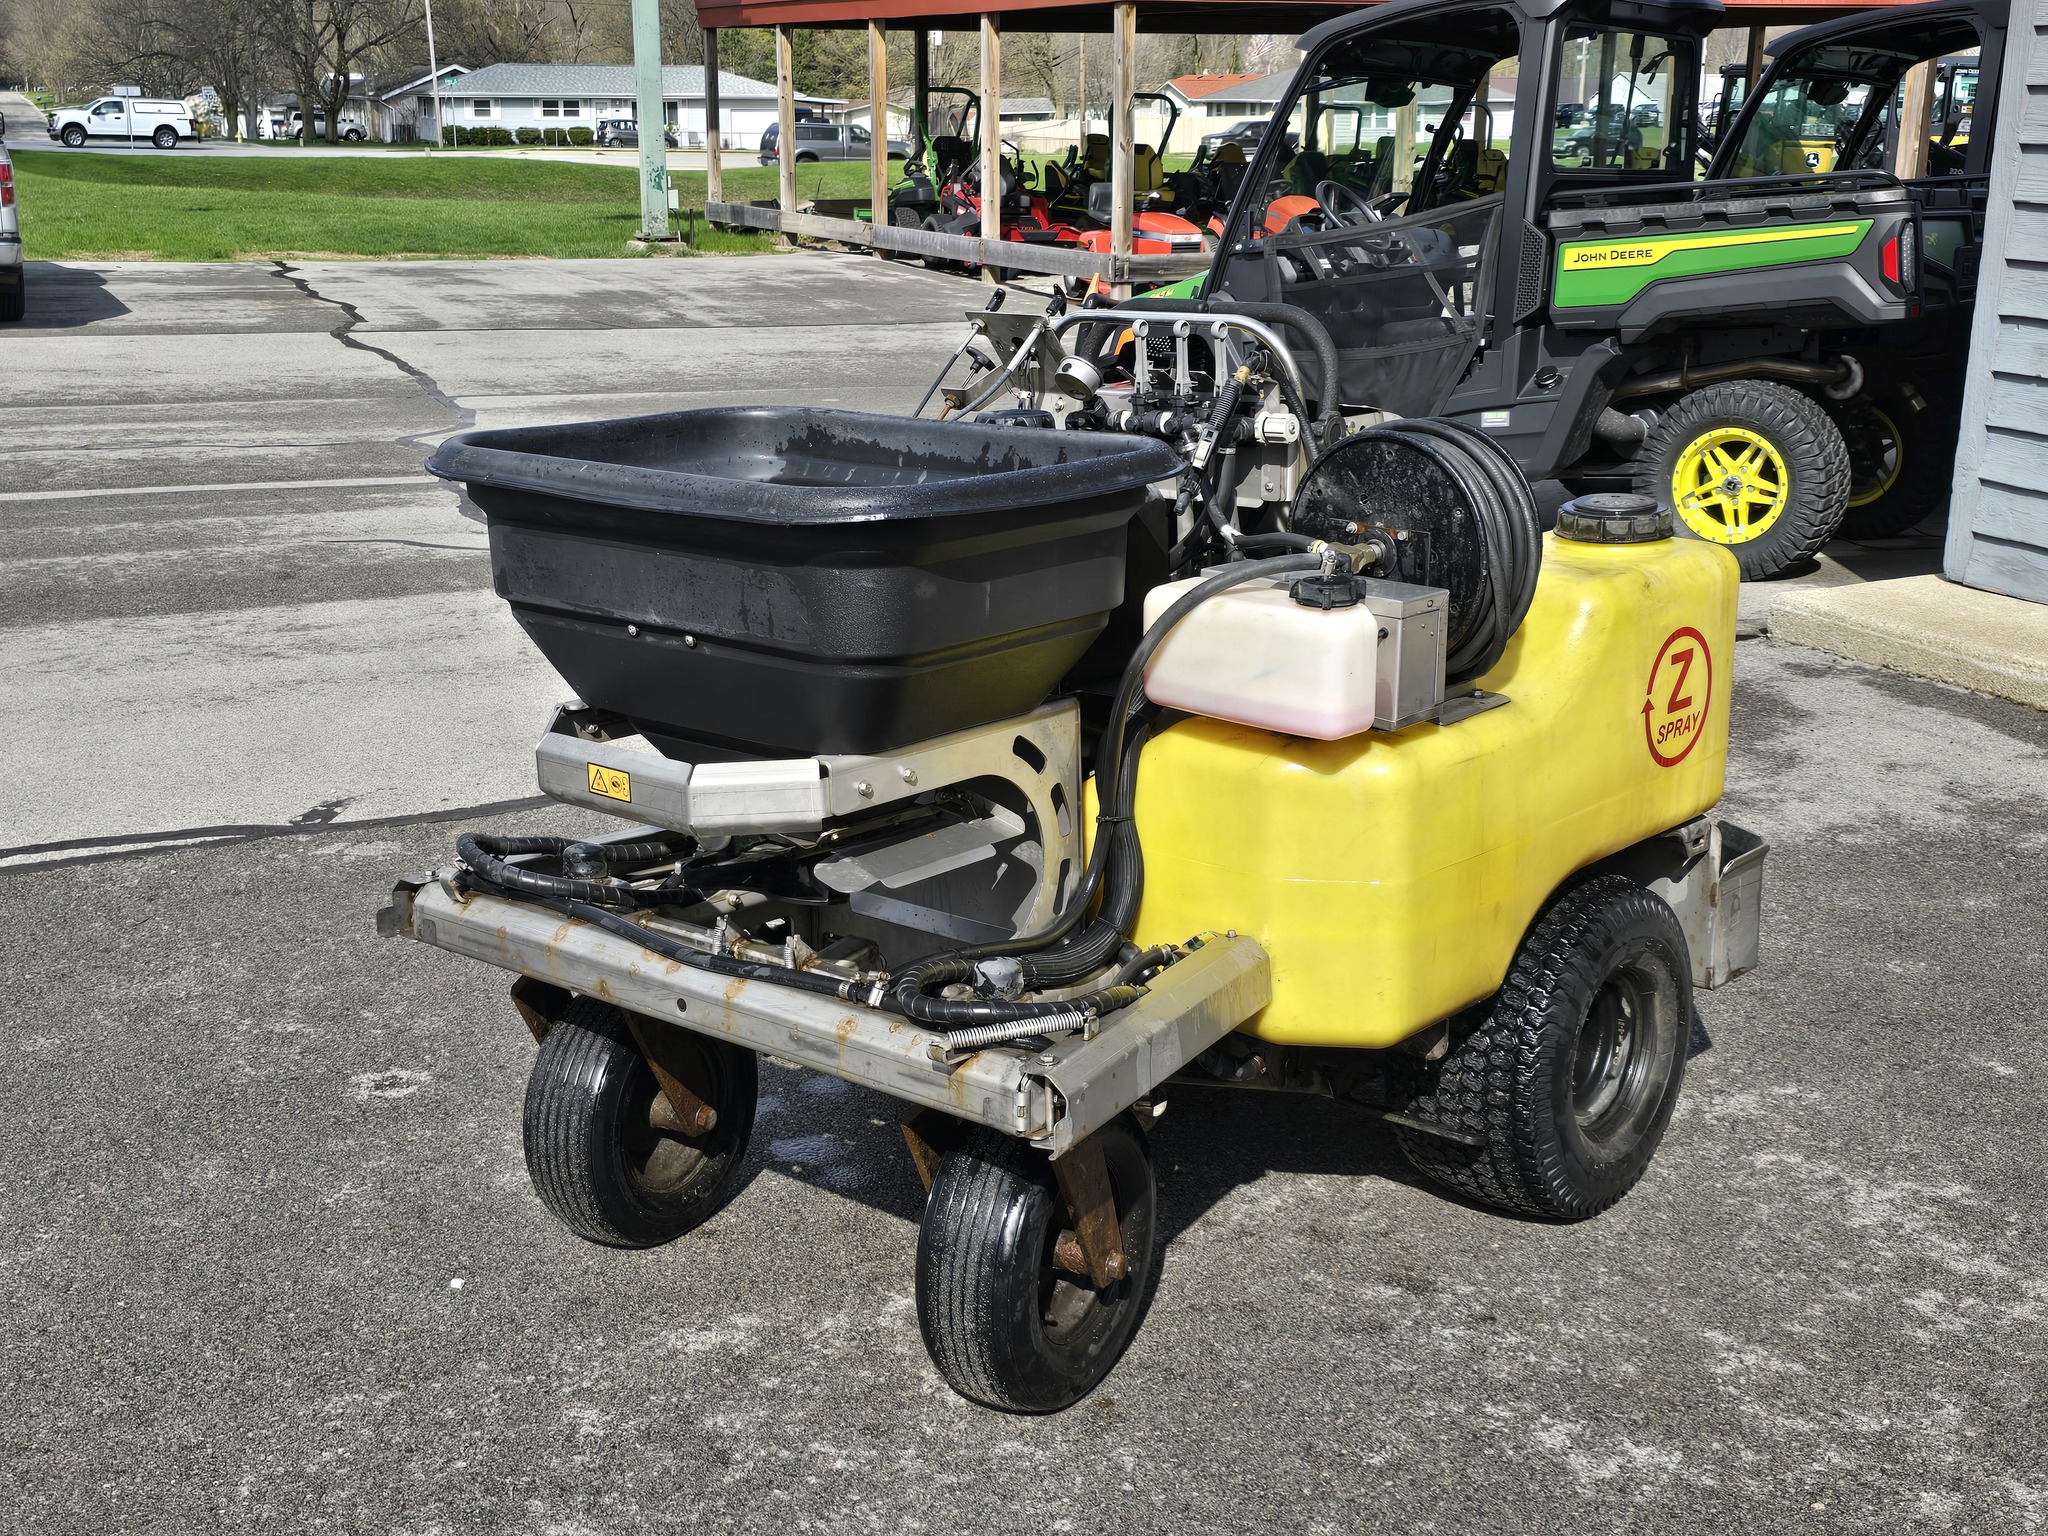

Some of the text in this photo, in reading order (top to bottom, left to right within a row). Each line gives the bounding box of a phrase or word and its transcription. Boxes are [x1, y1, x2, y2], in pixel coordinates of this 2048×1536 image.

[1573, 249, 1653, 263] JOHN DEERE
[1667, 647, 1694, 715] Z
[1656, 710, 1701, 745] SPRAY
